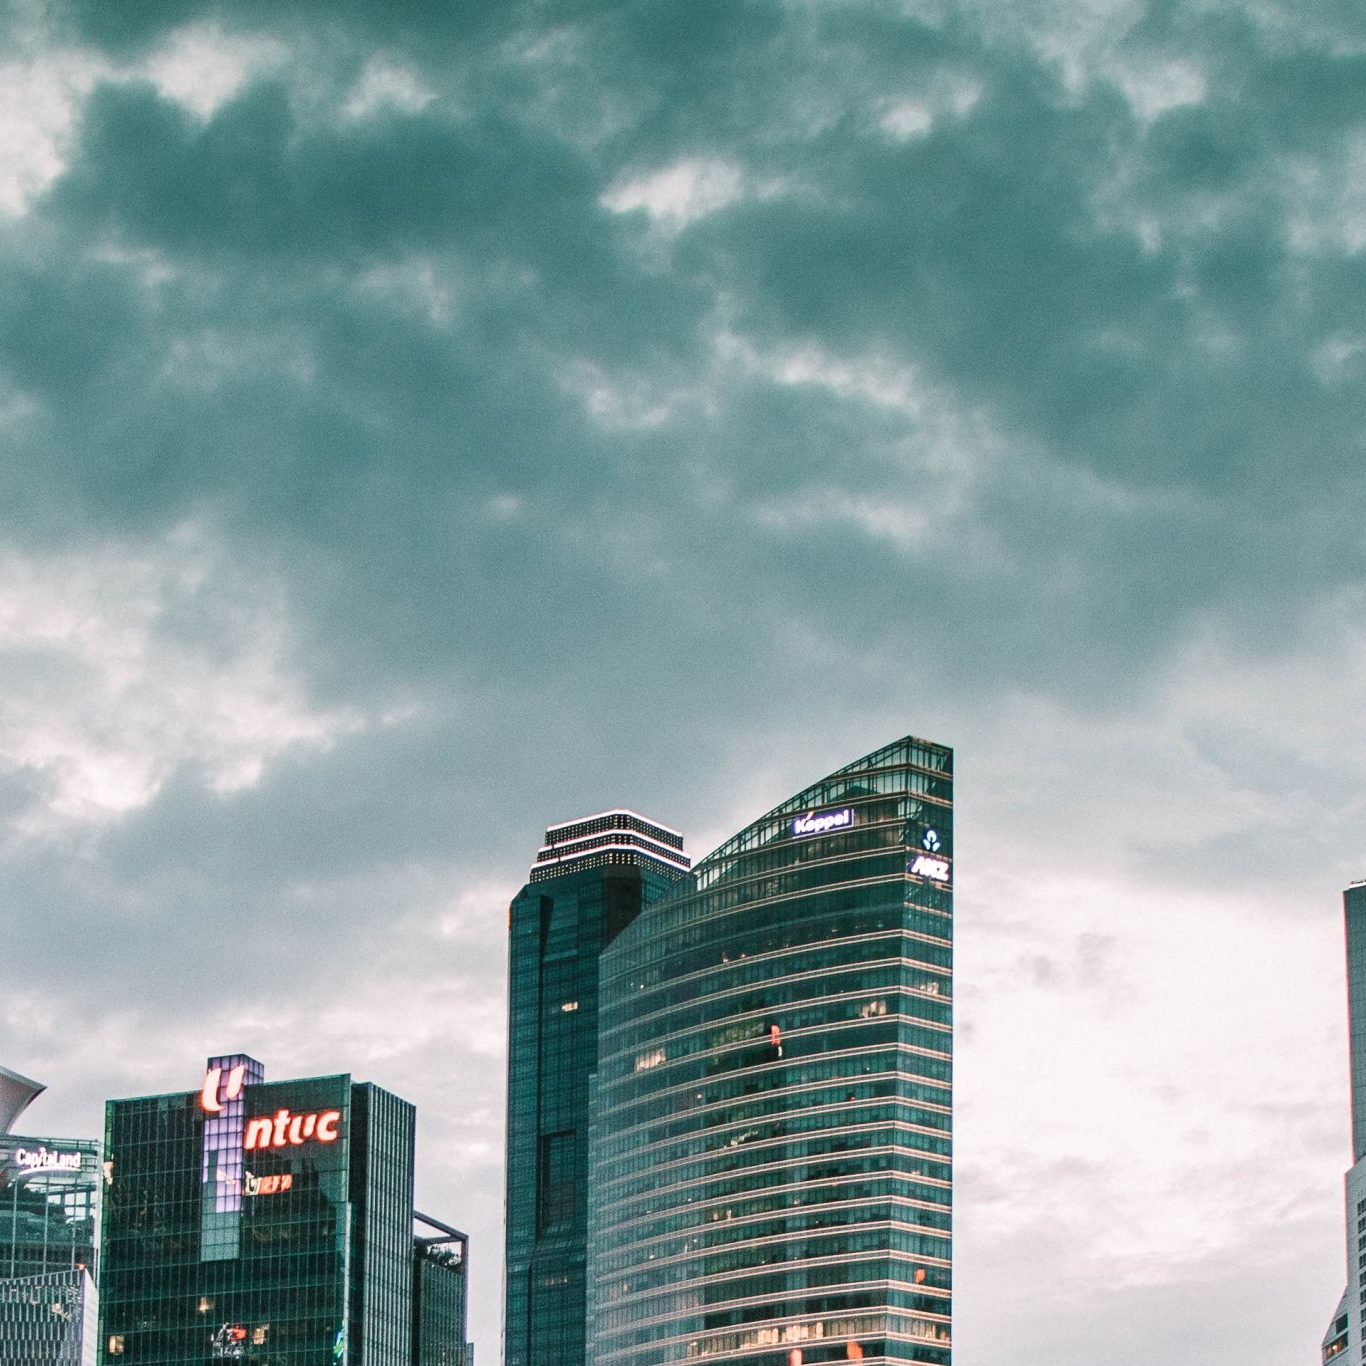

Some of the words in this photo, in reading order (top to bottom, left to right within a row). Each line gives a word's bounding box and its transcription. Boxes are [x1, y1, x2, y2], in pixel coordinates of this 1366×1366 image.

[794, 809, 849, 834] Keppel
[244, 1109, 341, 1149] ntuc
[16, 1146, 81, 1169] CapitaLand
